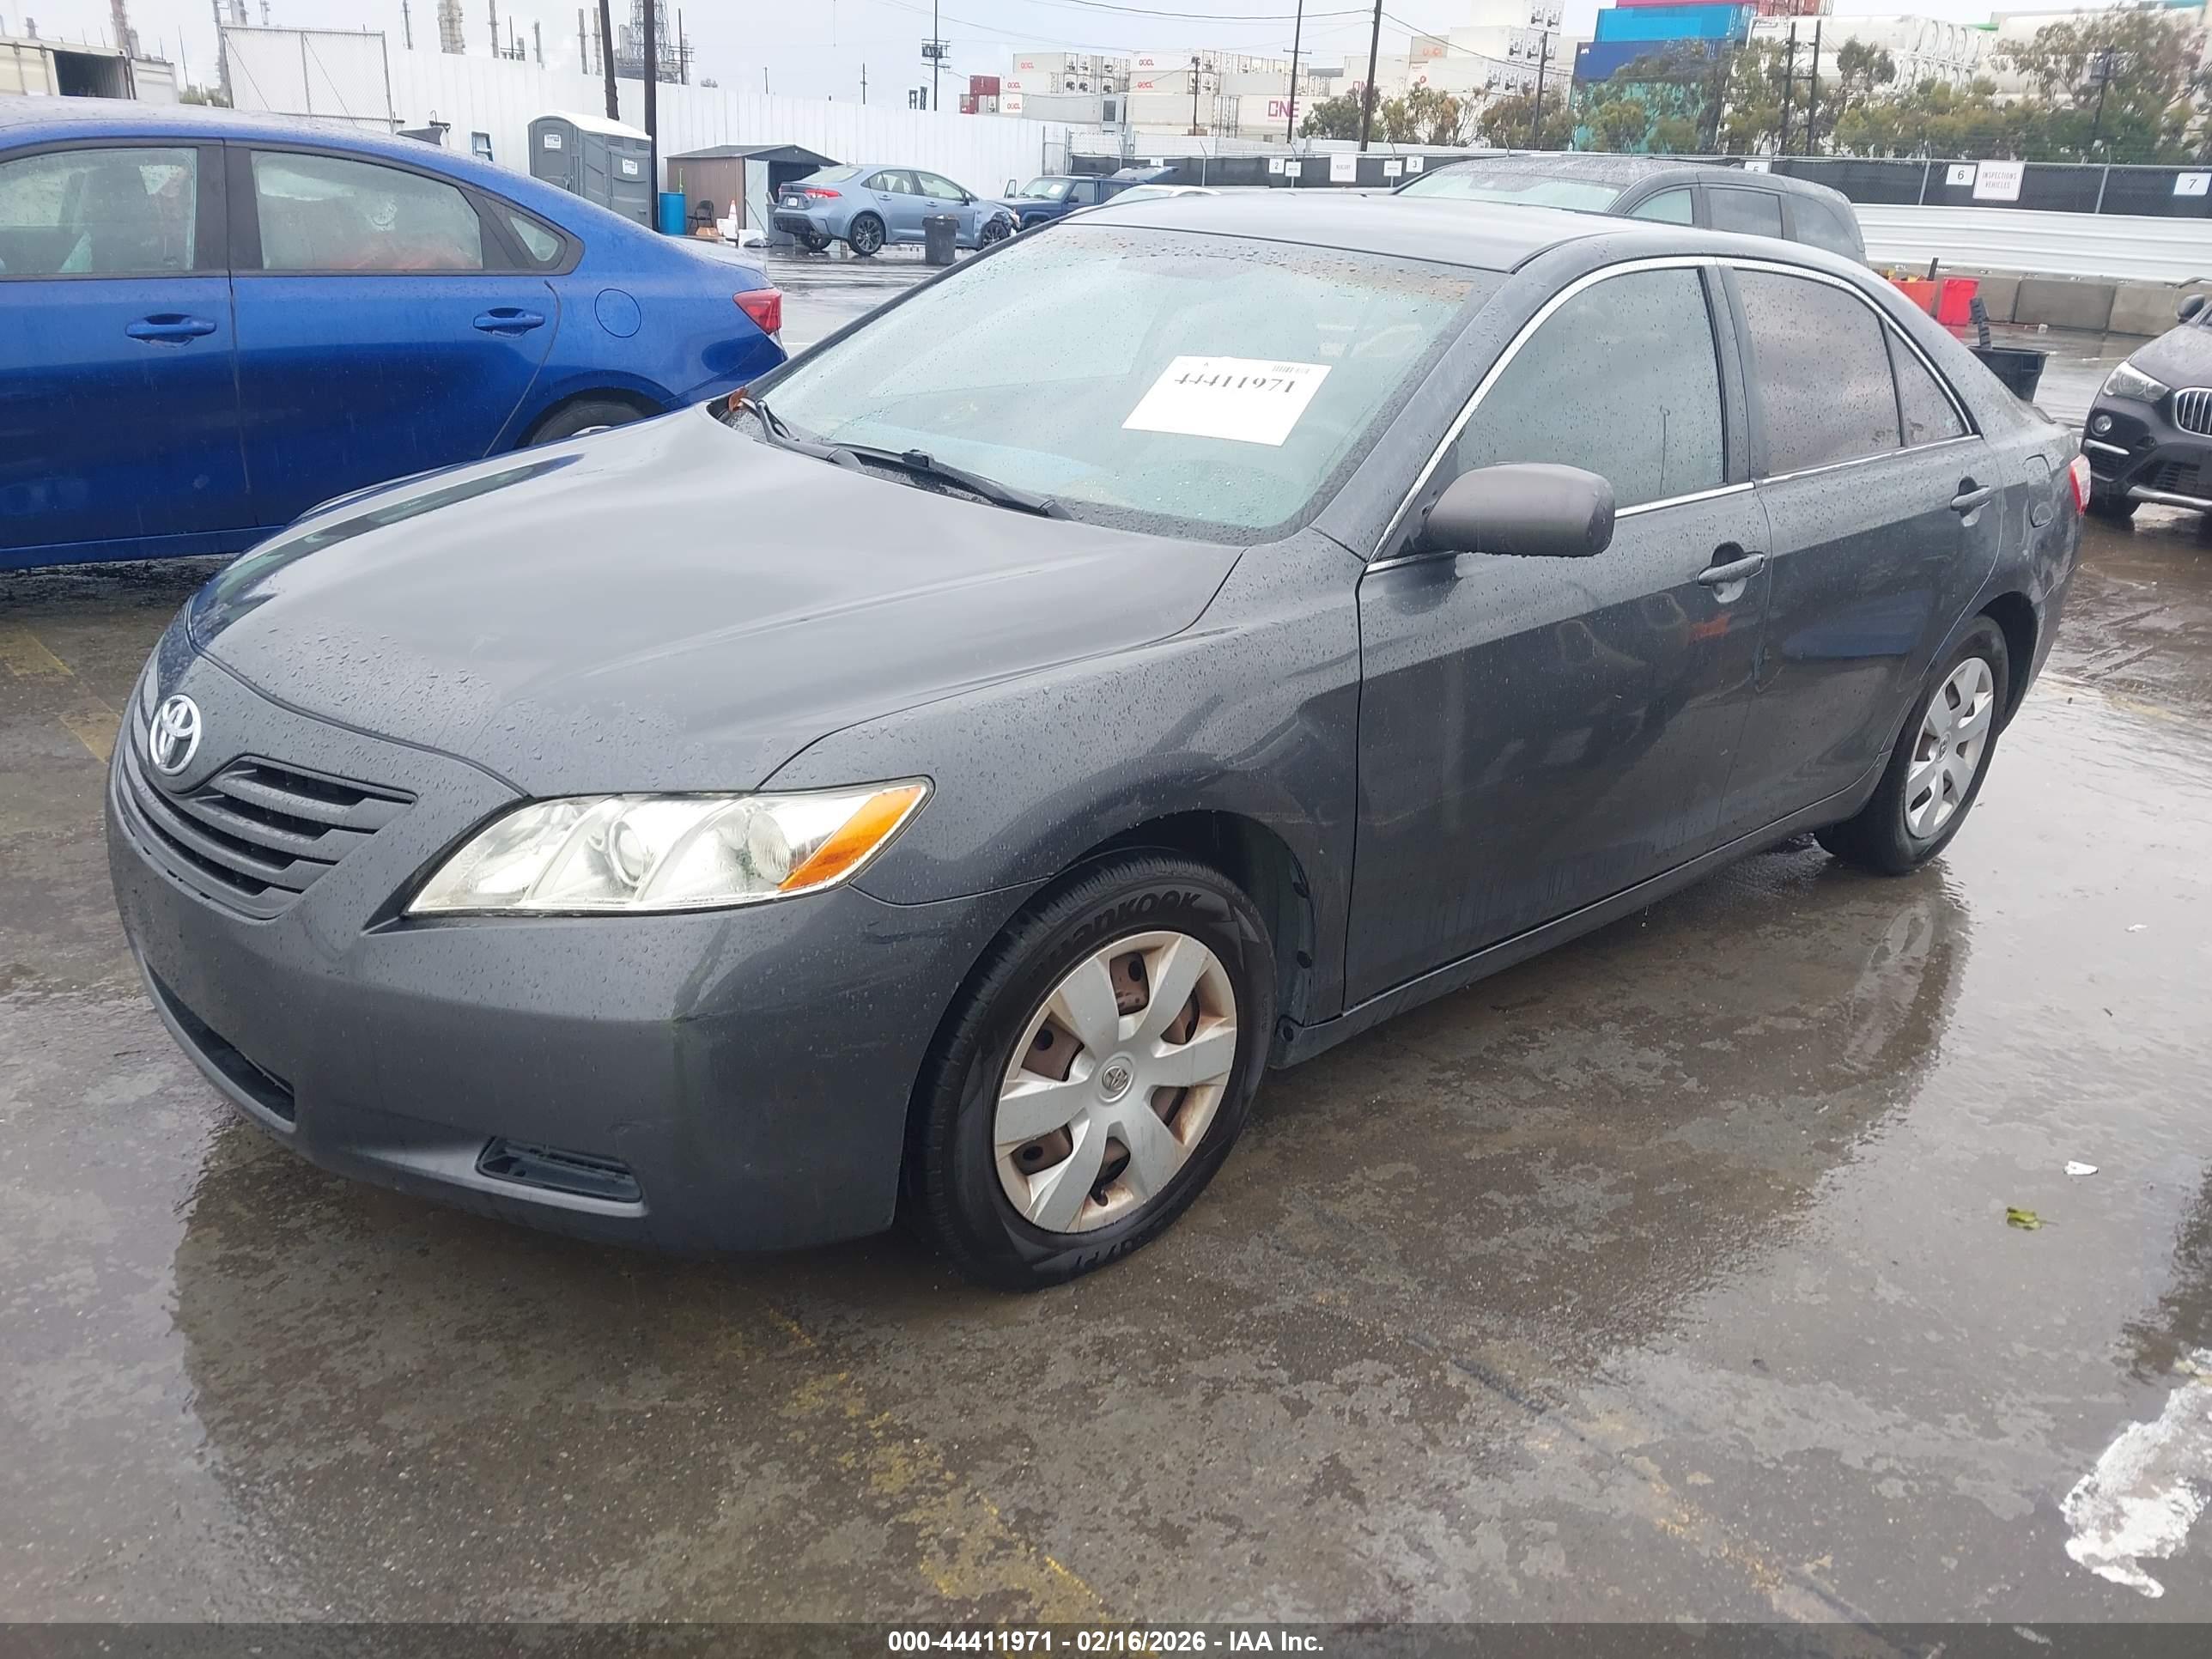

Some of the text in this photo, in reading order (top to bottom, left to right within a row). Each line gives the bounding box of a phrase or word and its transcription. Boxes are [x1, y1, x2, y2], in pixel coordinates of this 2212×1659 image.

[1267, 100, 1300, 118] ONE
[1957, 170, 1965, 180] 6
[2189, 178, 2198, 190] 7
[1174, 372, 1296, 393] 44411971
